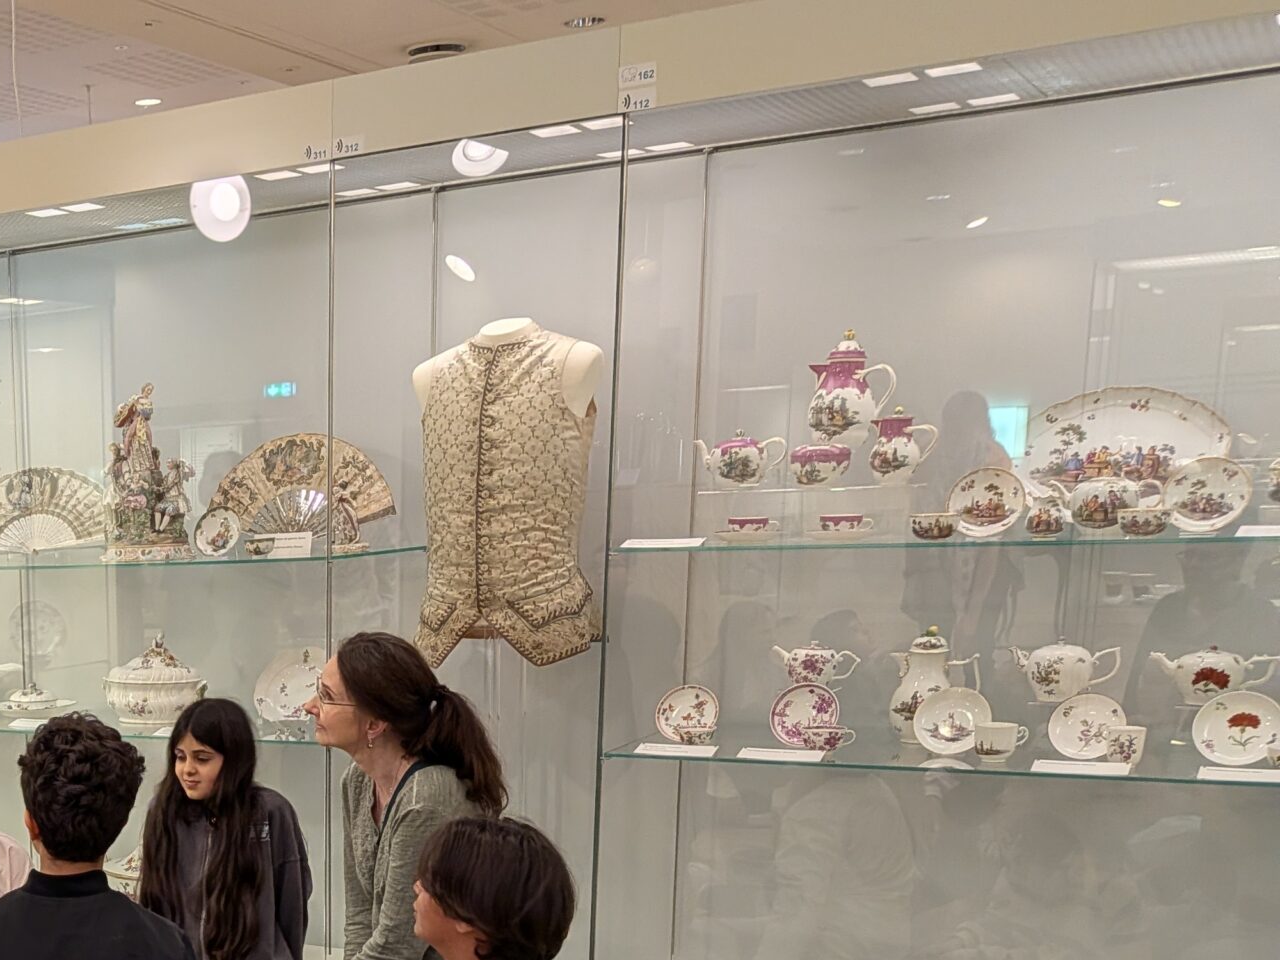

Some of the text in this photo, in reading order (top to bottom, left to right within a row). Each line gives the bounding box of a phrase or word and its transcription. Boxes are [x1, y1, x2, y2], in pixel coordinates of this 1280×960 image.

[638, 70, 654, 80] 162
[633, 99, 650, 109] 112
[345, 143, 358, 152] 312
[314, 150, 326, 159] 311
